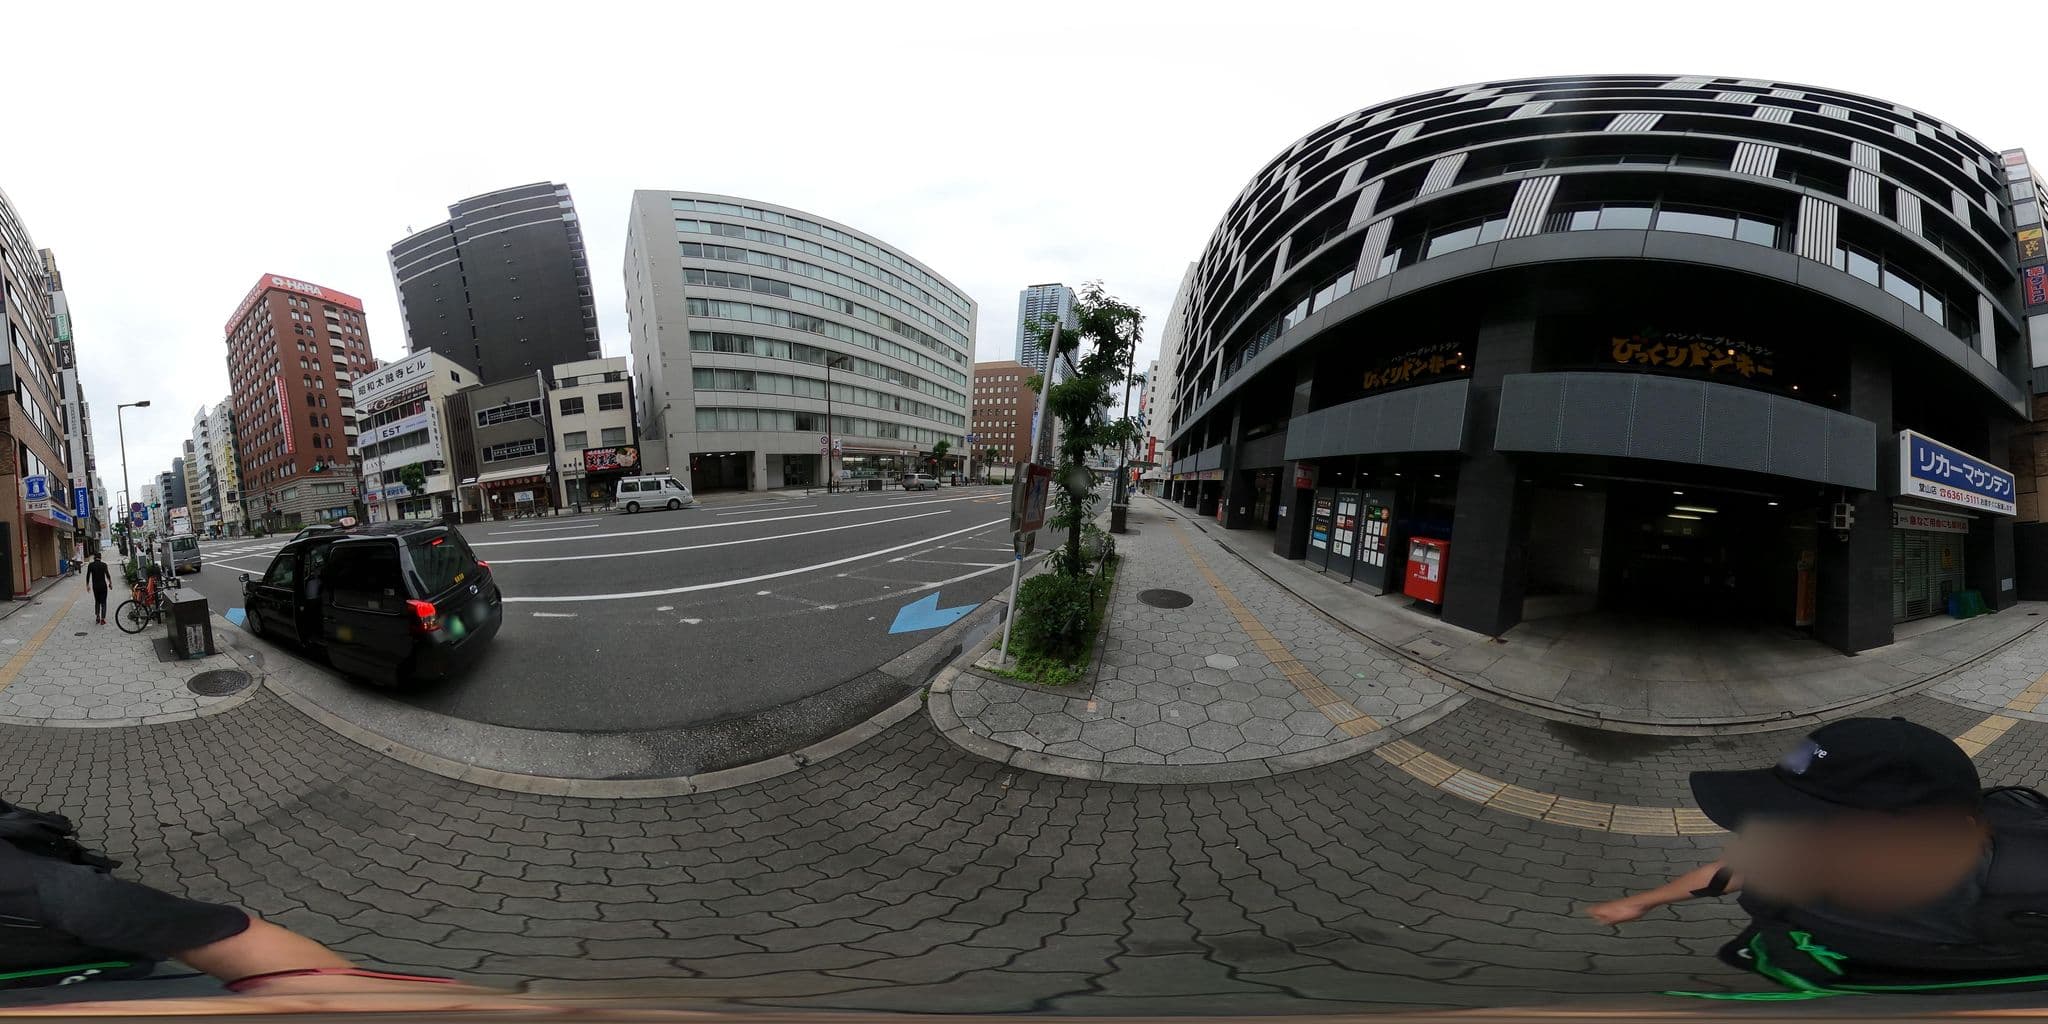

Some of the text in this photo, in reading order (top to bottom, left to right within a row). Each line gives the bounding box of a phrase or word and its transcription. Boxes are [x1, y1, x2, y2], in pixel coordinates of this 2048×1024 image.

[1612, 337, 1773, 377] びっくりドンキー
[1919, 447, 2011, 496] リカーマウンテン
